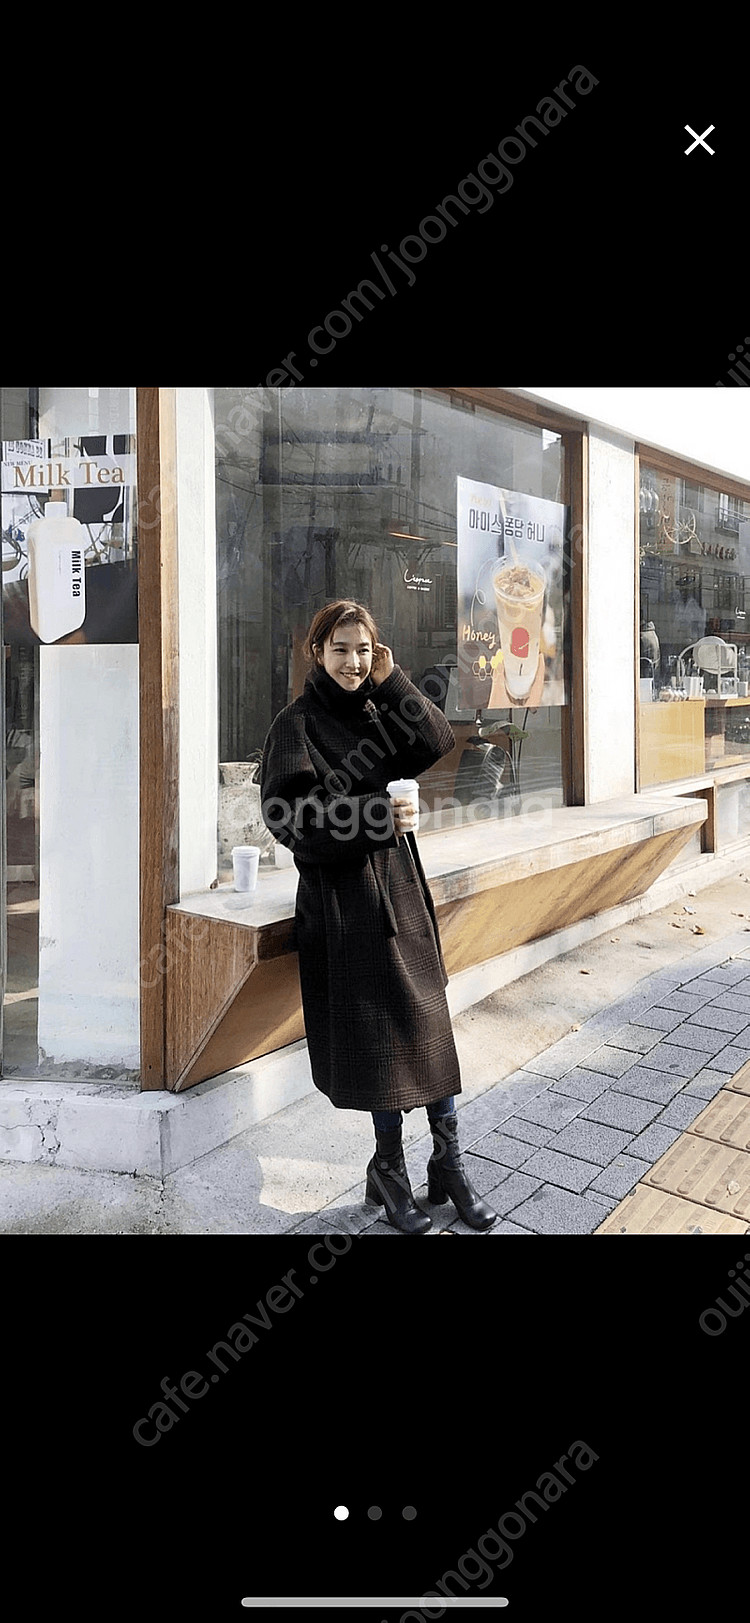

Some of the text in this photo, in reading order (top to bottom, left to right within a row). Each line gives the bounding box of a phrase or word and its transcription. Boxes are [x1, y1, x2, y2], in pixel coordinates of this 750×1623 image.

[12, 461, 126, 488] Milk Tea
[468, 508, 502, 534] 아이스
[527, 520, 545, 542] 허니
[71, 550, 82, 597] Milk Tea
[462, 624, 496, 650] Honey
